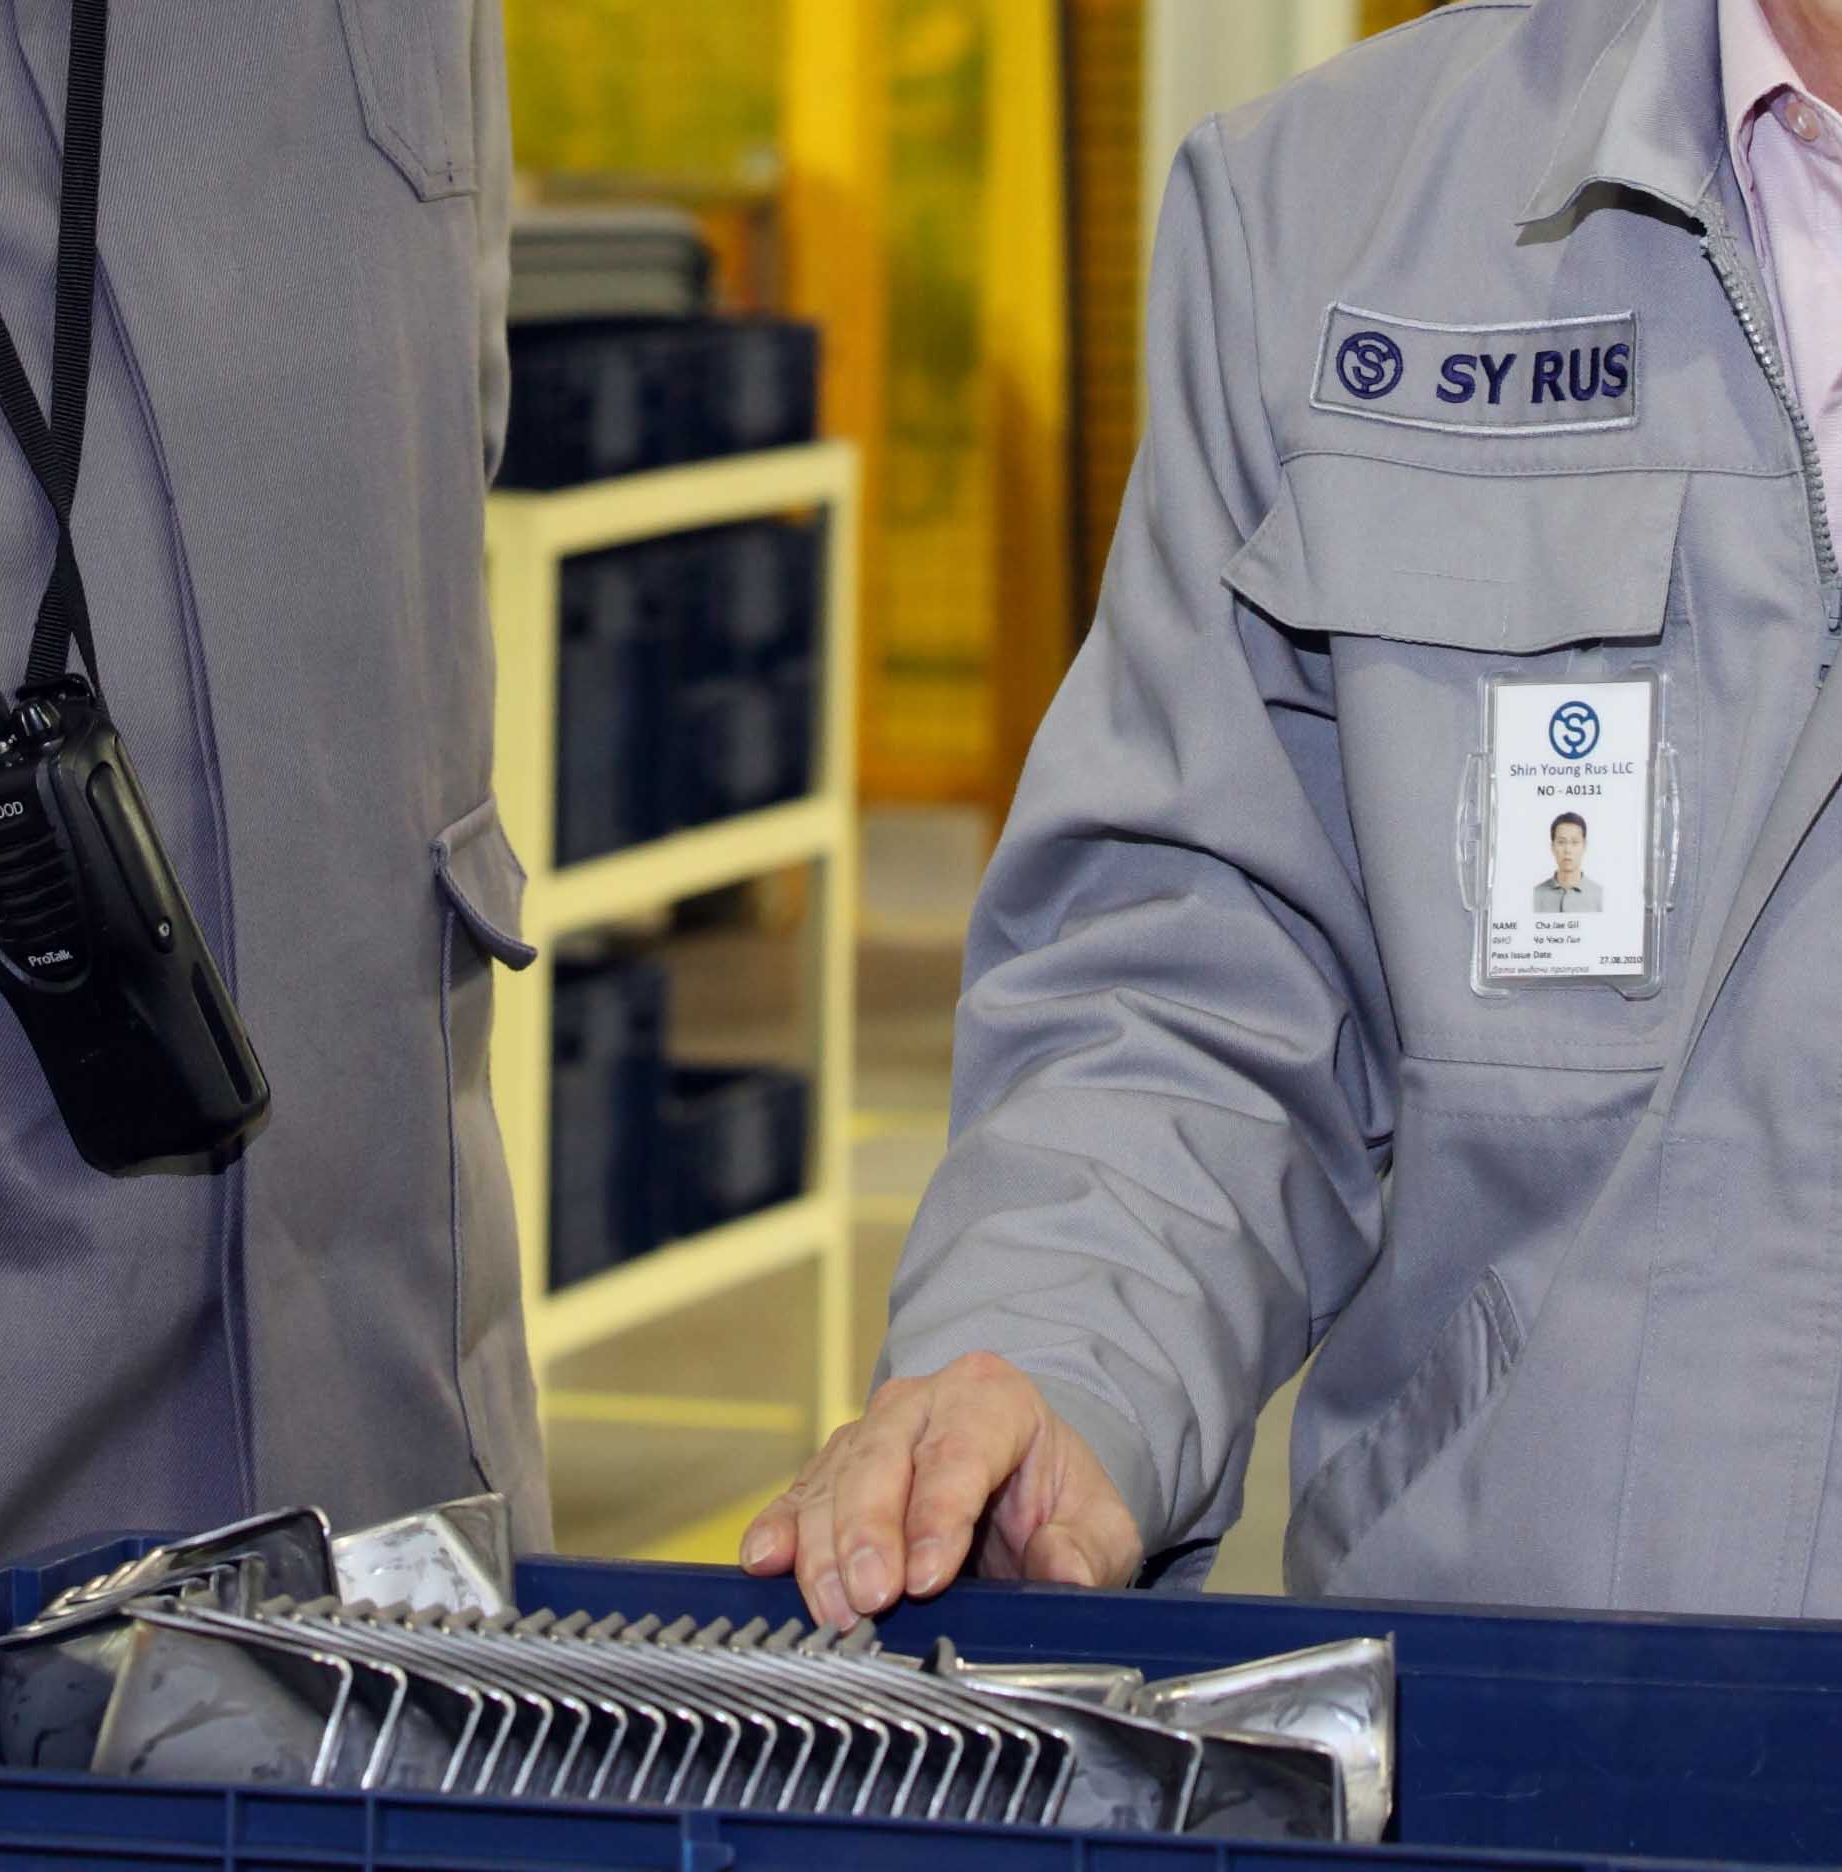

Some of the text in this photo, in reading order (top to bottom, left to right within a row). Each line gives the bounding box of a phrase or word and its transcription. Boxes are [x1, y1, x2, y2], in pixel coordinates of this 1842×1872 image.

[1436, 354, 1517, 404] SY
[1531, 343, 1629, 403] RUS
[1510, 761, 1634, 778] Shin Young Rus LLC
[1537, 785, 1555, 796] NO
[1565, 784, 1602, 796] A0131
[1492, 922, 1517, 930] NAME
[28, 949, 73, 967] ProTalk
